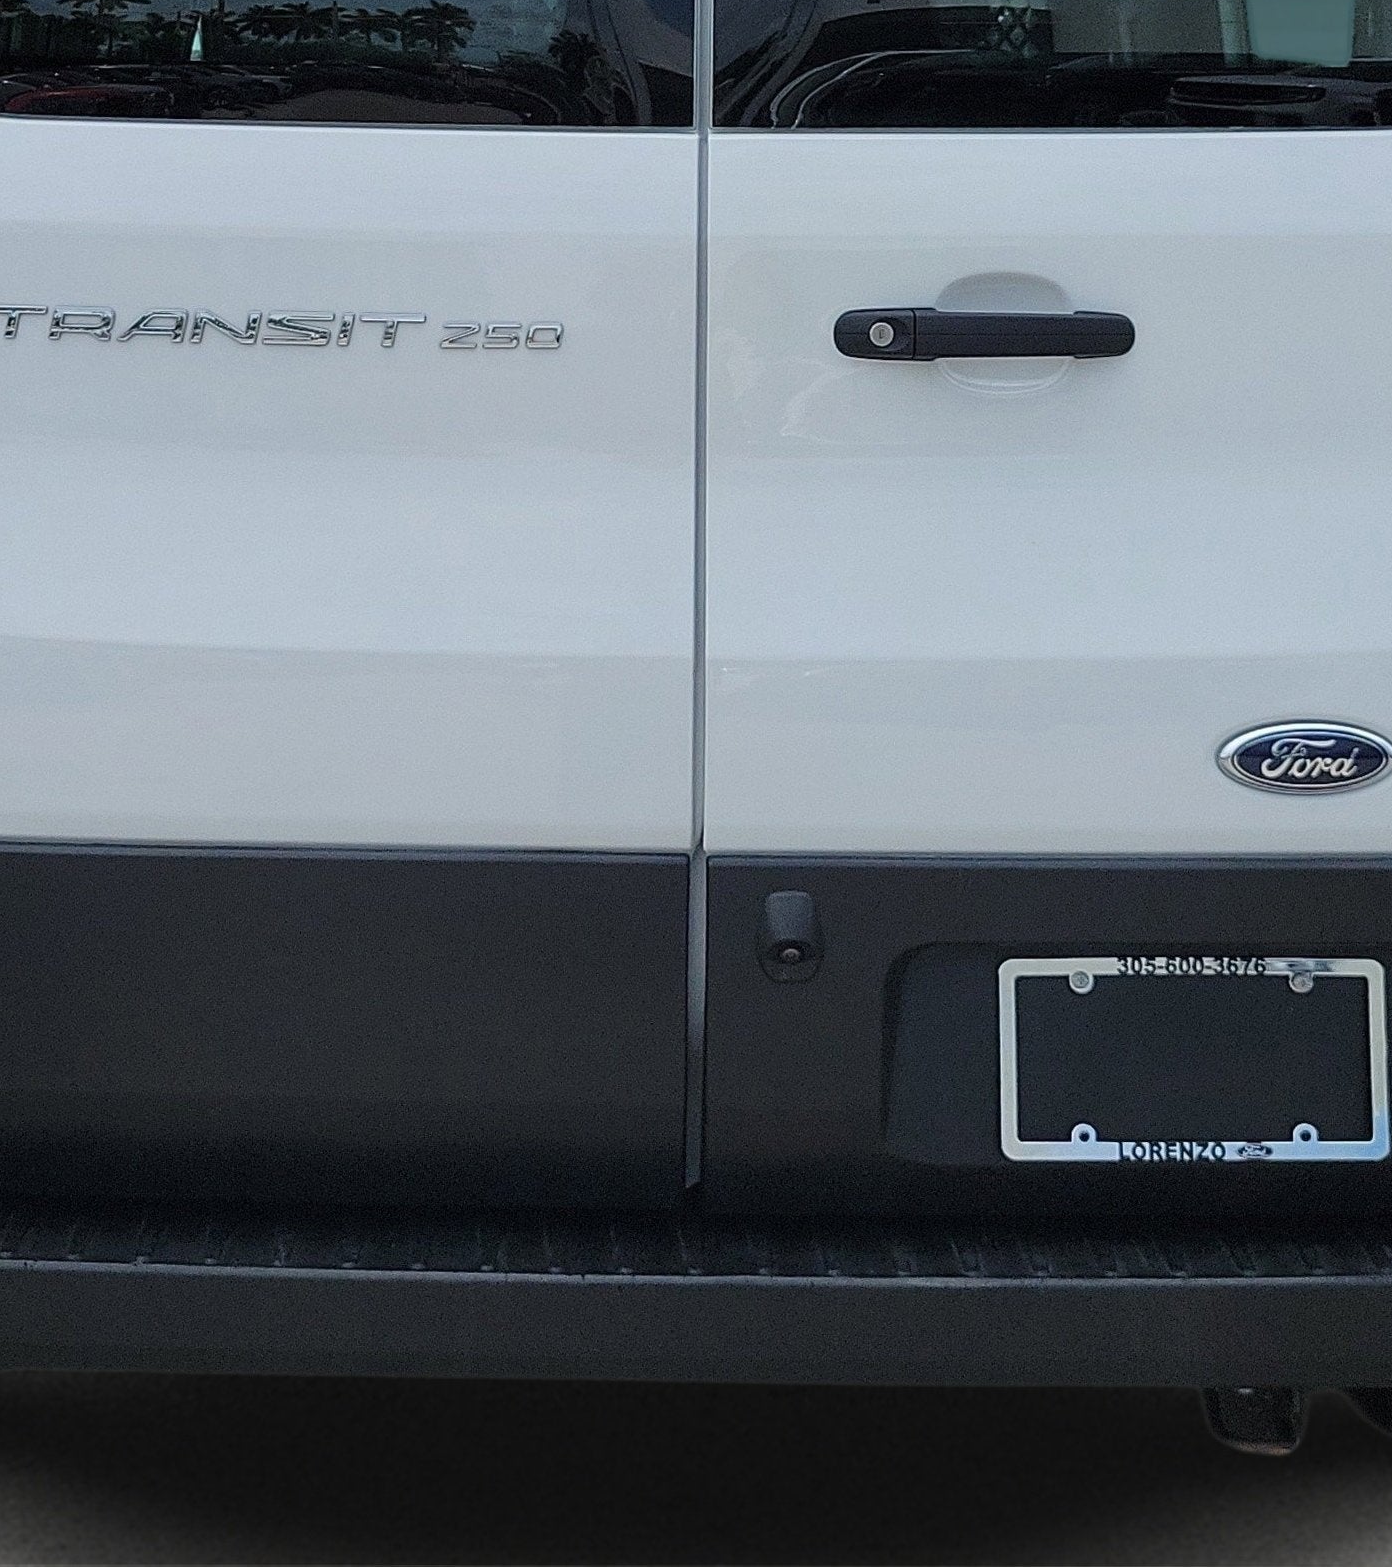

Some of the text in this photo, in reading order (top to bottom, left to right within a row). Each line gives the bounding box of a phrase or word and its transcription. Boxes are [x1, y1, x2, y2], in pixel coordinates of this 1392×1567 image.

[439, 321, 565, 350] 250
[1260, 737, 1359, 779] Ford
[1116, 956, 1267, 976] 305-600-3676
[1119, 1141, 1226, 1161] LORENZO
